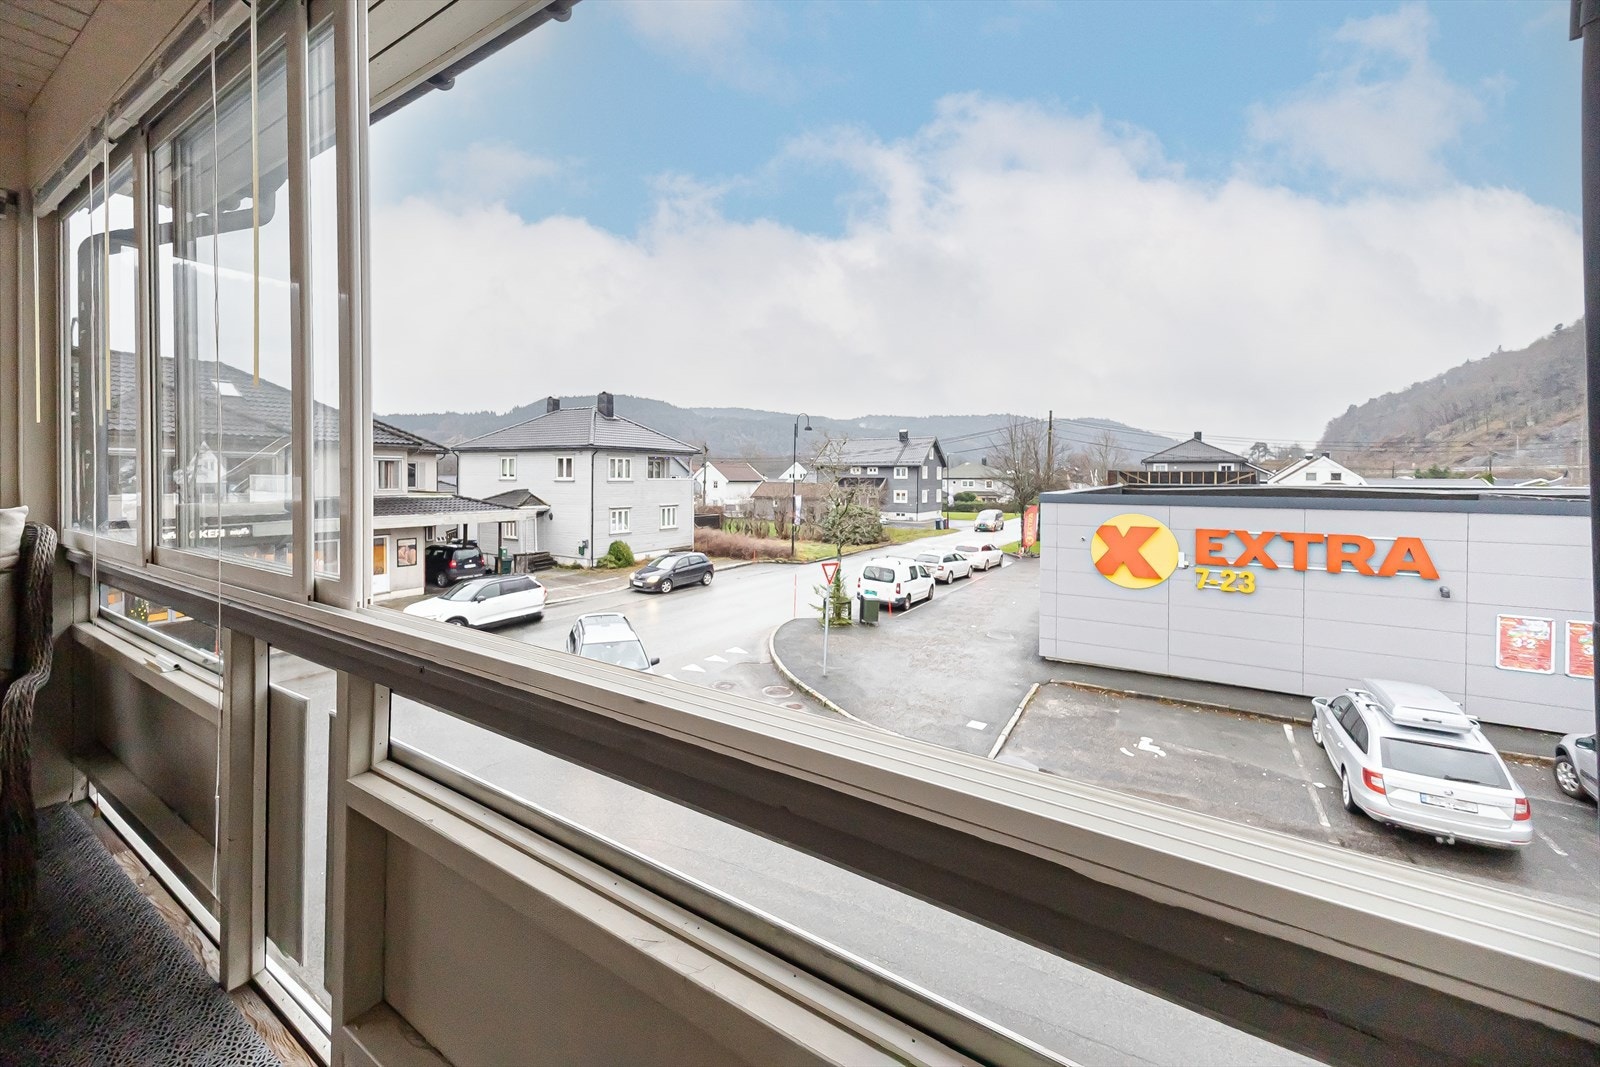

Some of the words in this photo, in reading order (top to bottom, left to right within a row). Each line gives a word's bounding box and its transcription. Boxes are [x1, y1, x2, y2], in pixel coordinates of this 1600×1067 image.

[1095, 525, 1162, 580] X
[1195, 528, 1440, 580] EXTRA
[1195, 567, 1256, 593] 7-23
